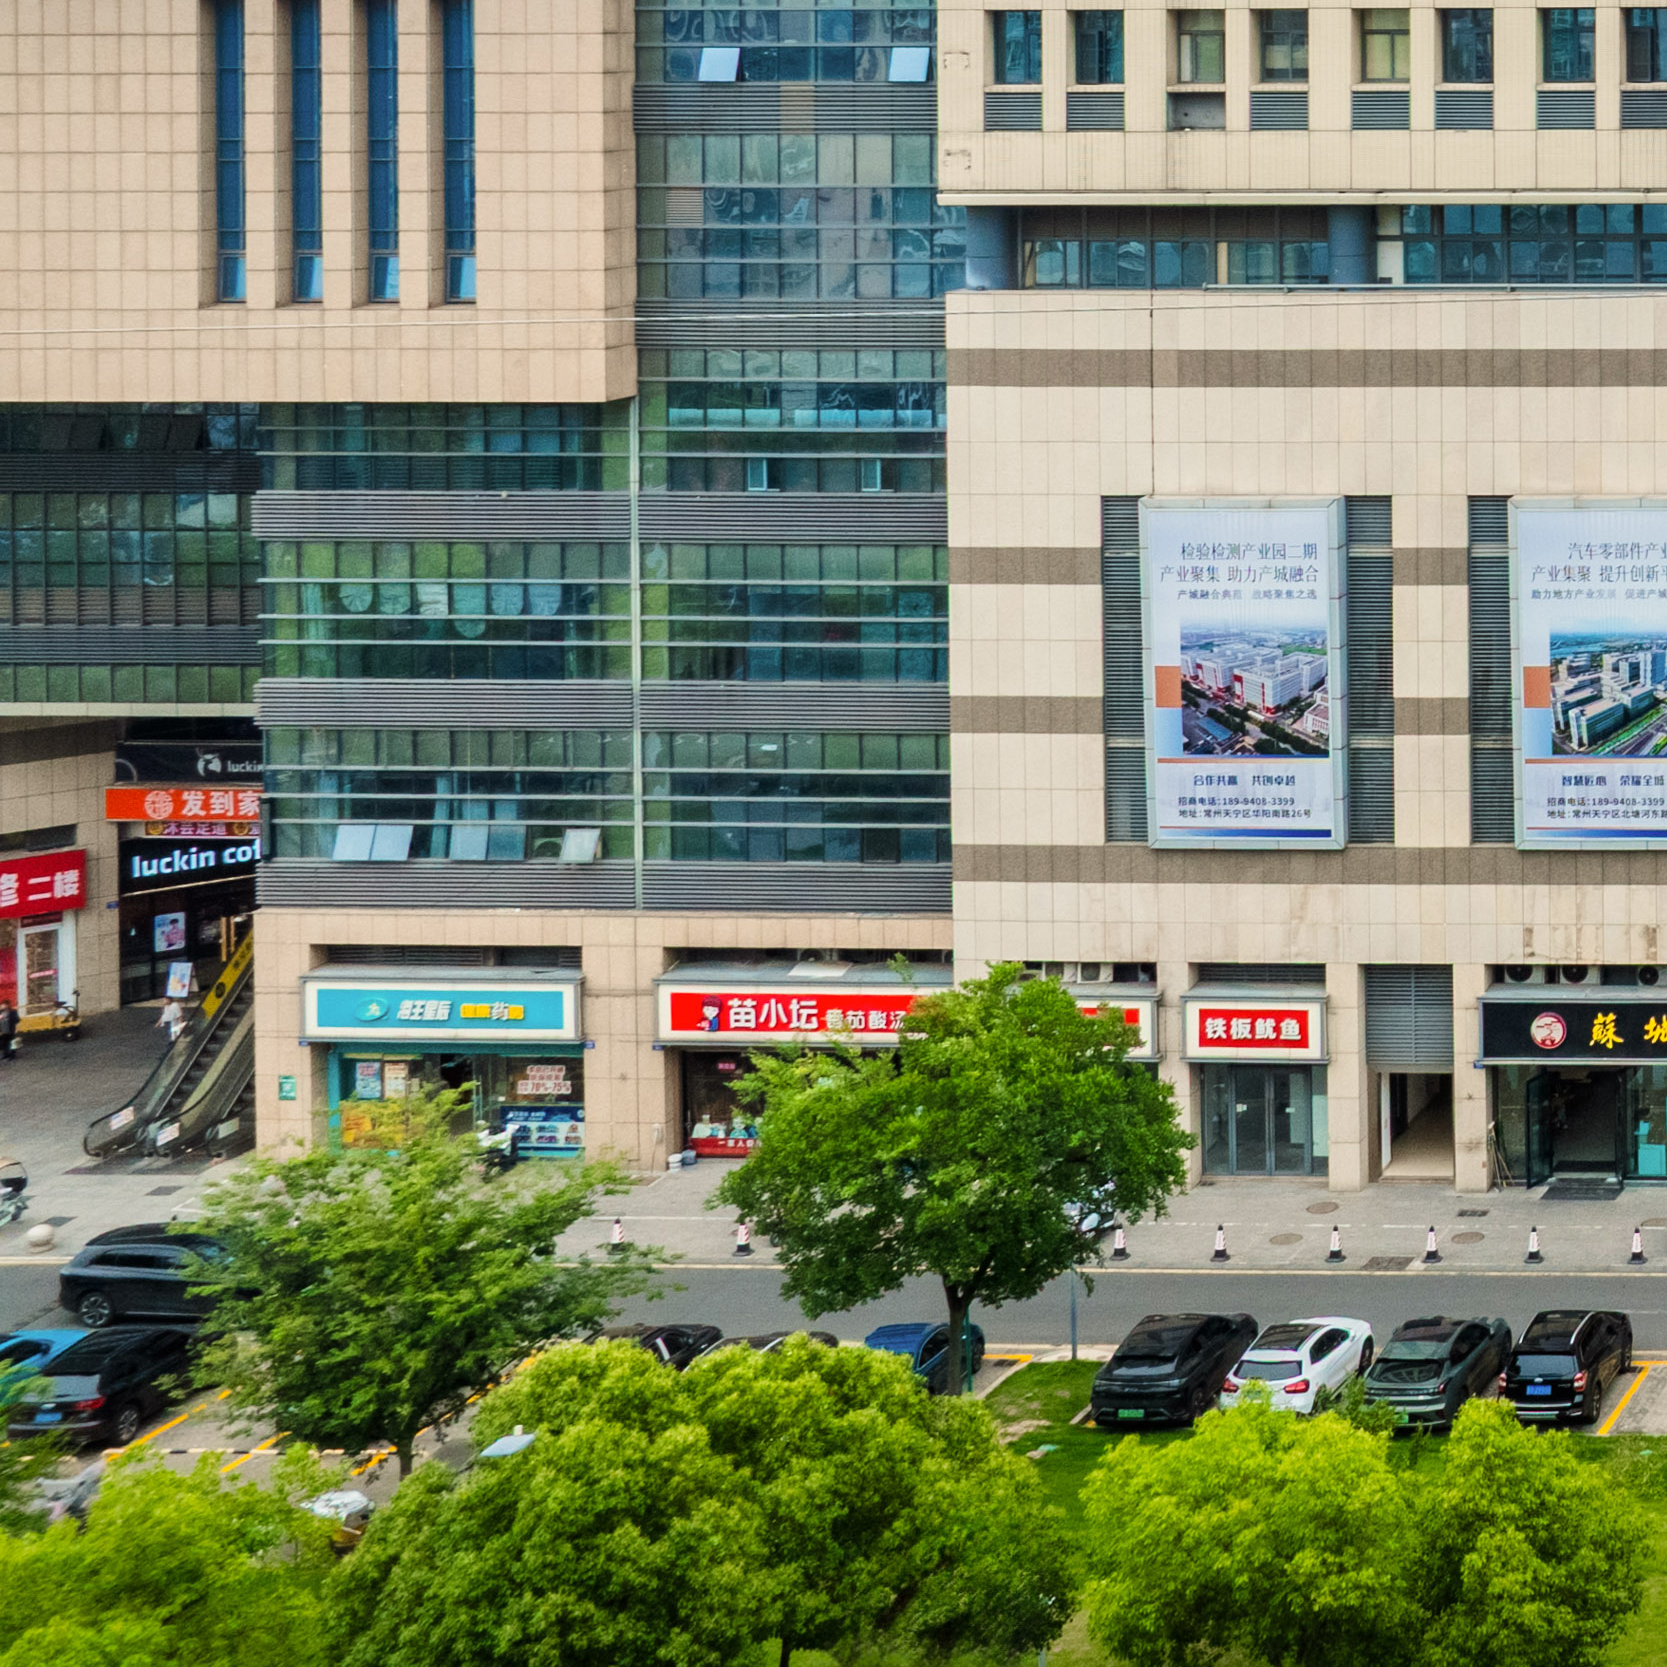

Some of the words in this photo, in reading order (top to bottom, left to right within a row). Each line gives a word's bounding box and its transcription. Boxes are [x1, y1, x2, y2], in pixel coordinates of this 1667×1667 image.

[1181, 542, 1318, 560] 检验检测产业园二期
[1160, 565, 1220, 583] 产业聚集
[1228, 565, 1319, 583] 助力产城融合
[1531, 565, 1591, 583] 产业集聚
[132, 847, 216, 878] luckin
[28, 869, 79, 901] 二楼
[727, 998, 819, 1030] 苗小坛
[1205, 1016, 1302, 1041] 铁板鱿鱼
